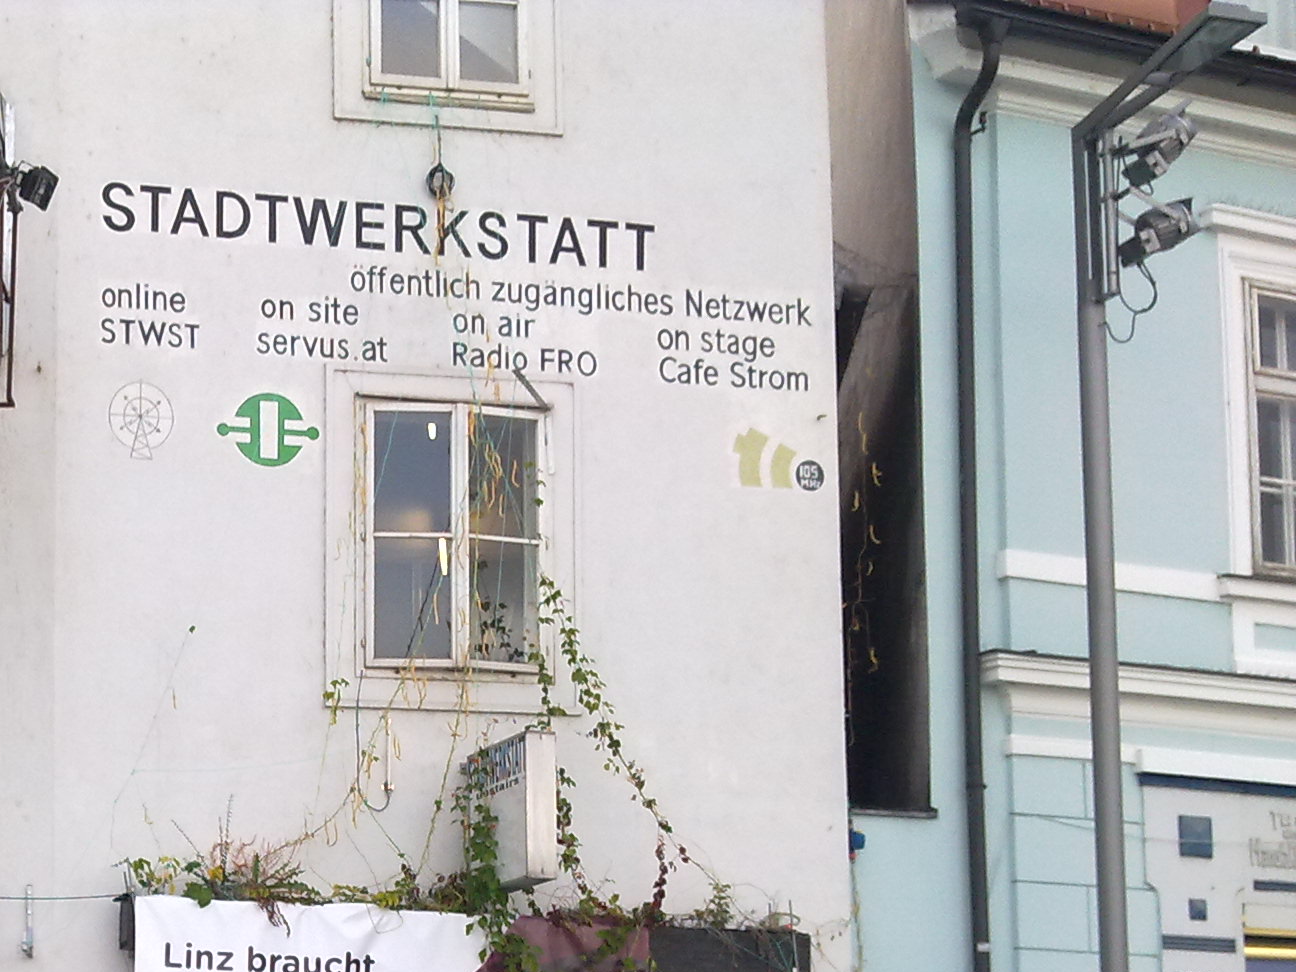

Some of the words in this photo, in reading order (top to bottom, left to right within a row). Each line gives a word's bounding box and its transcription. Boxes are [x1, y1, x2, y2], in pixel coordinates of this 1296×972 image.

[101, 181, 656, 272] STADTWERKSTATT
[101, 283, 186, 313] online
[260, 298, 294, 320] on
[308, 296, 360, 326] site
[350, 264, 481, 300] öffentlich
[491, 280, 674, 316] zugängliches
[685, 288, 813, 327] Netzwerk
[101, 318, 200, 349] STWST
[453, 312, 486, 335] on
[497, 314, 536, 338] air
[256, 332, 388, 363] servus.at
[452, 342, 528, 371] Radio
[540, 348, 598, 377] FRO
[657, 328, 690, 351] on
[700, 328, 776, 363] stage
[659, 356, 719, 386] Cafe
[730, 361, 810, 392] Strom
[163, 941, 234, 972] Linz
